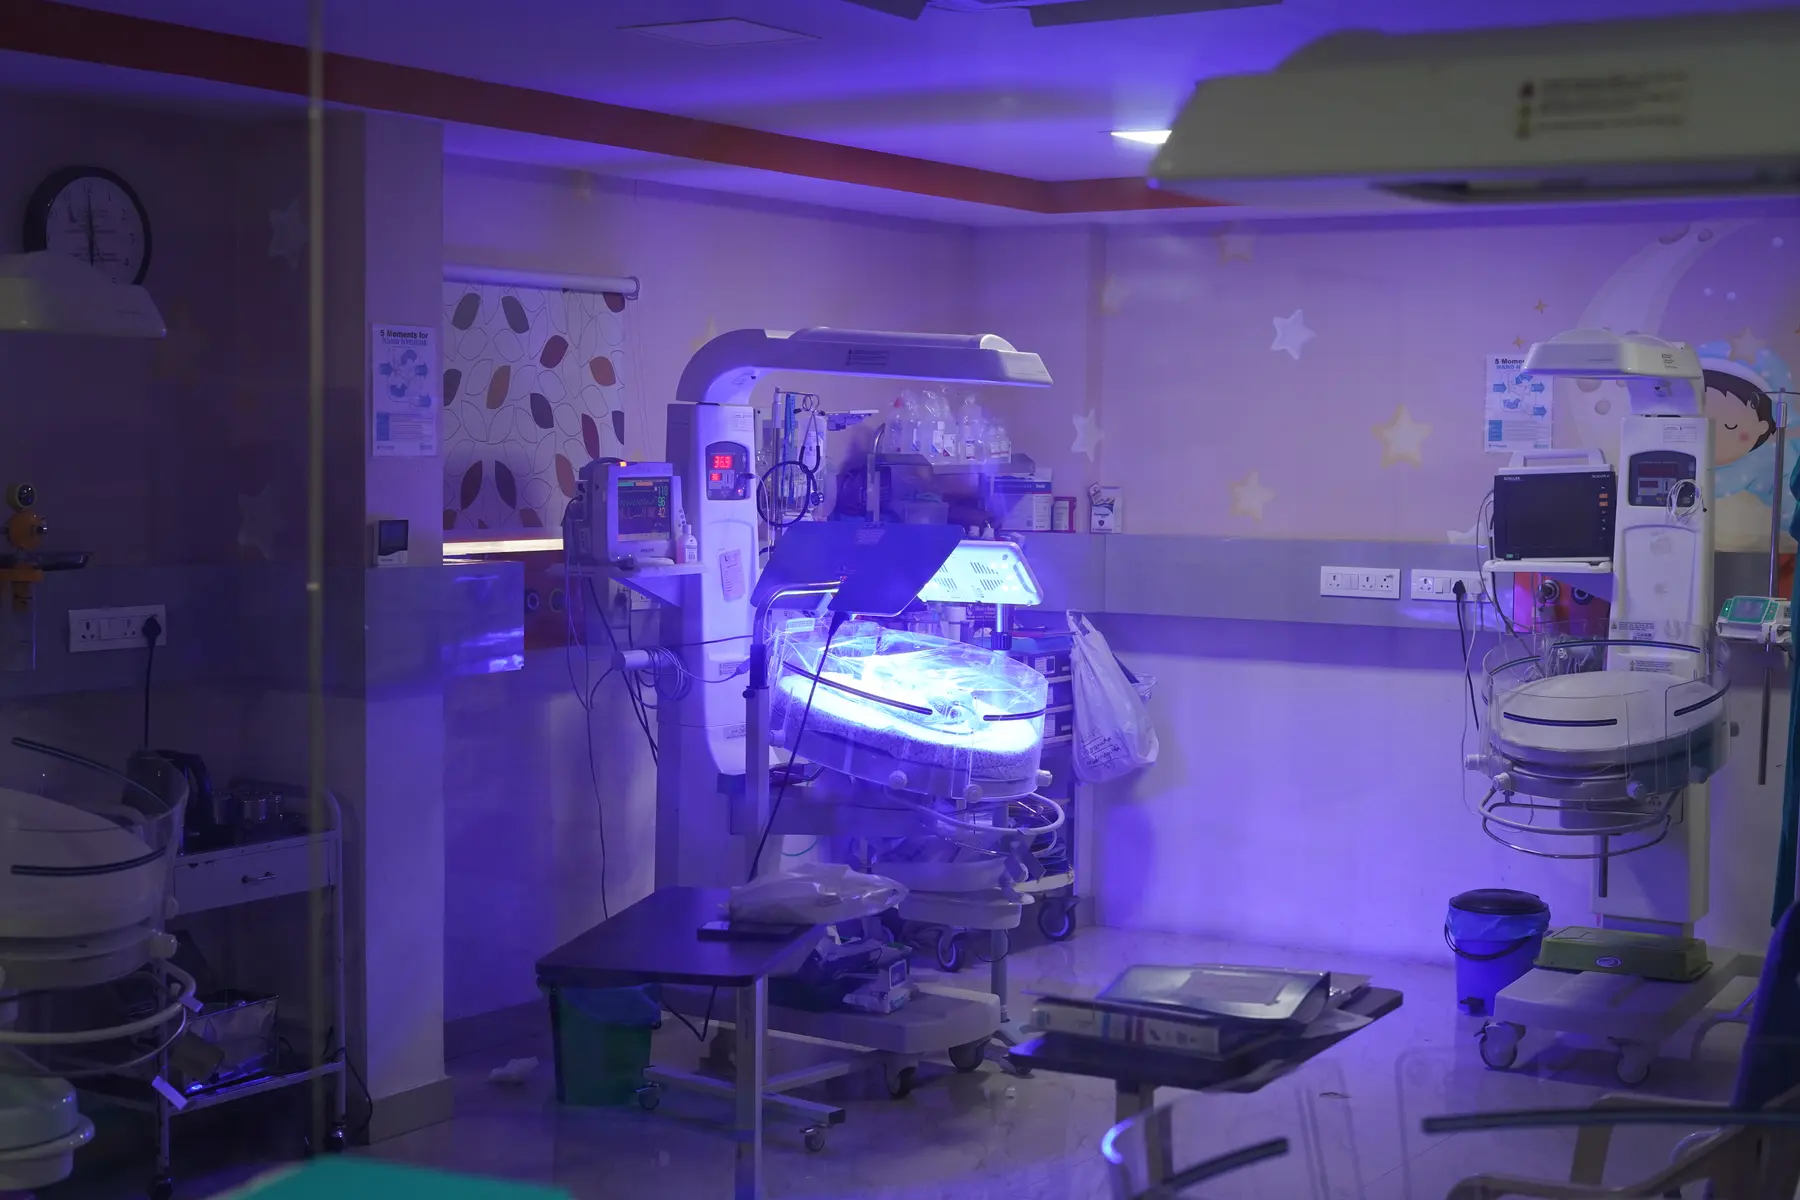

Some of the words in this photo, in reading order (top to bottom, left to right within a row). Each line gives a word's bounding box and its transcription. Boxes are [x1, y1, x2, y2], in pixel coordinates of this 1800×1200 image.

[380, 329, 385, 337] 5
[387, 329, 417, 338] Moments
[419, 331, 429, 339] for
[657, 496, 666, 507] 96
